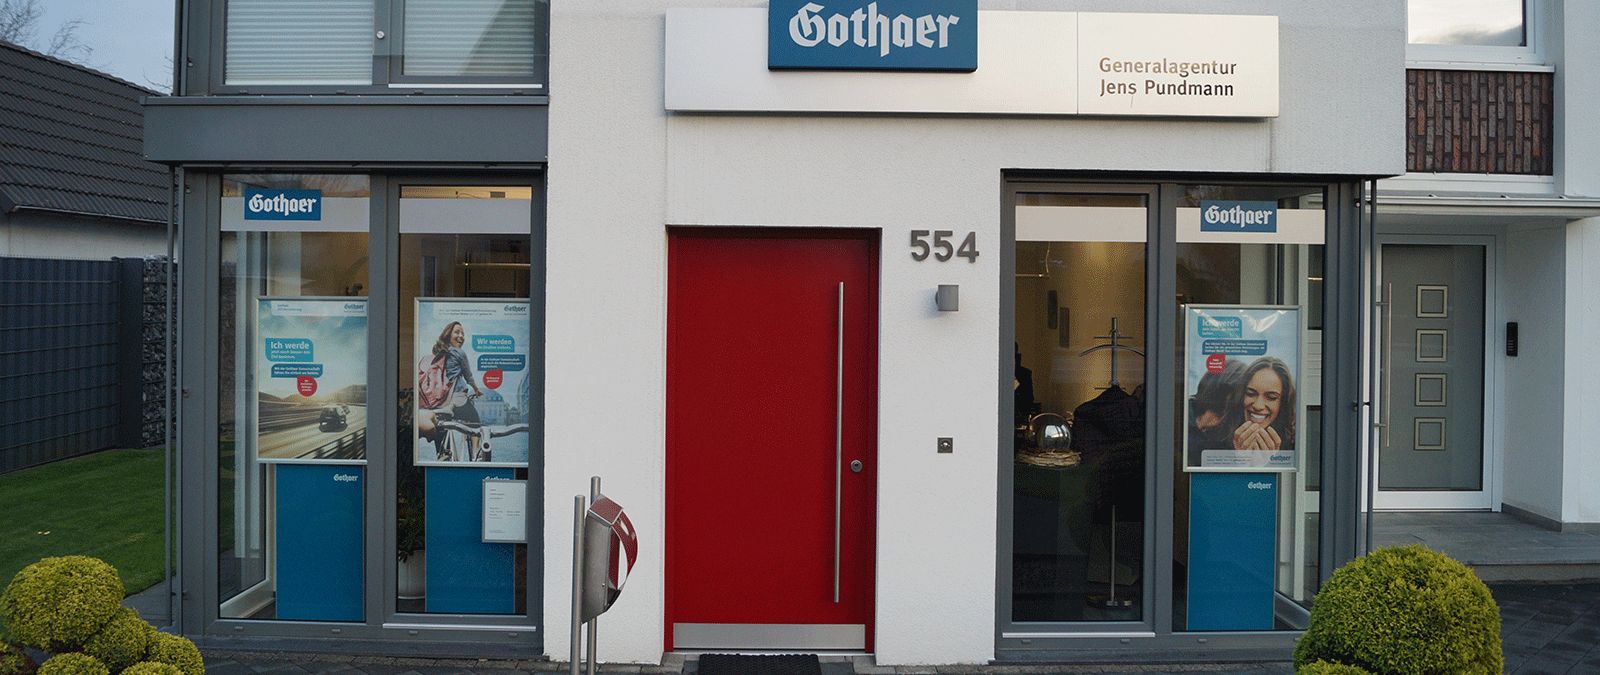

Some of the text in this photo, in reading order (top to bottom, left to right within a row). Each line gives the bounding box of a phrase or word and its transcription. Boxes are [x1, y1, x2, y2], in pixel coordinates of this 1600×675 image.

[789, 2, 960, 57] Gothaer
[1099, 57, 1237, 78] Generalagentur
[1100, 79, 1234, 97] Jens Pundmann
[248, 193, 317, 217] Gothaer
[1204, 204, 1273, 228] Gothaer
[910, 229, 980, 264] 554
[503, 304, 527, 312] Gothaer
[270, 341, 310, 349] Ich werde
[1270, 454, 1291, 462] Gothaer
[333, 473, 358, 482] Gothaer
[1247, 481, 1272, 490] Gothaer
